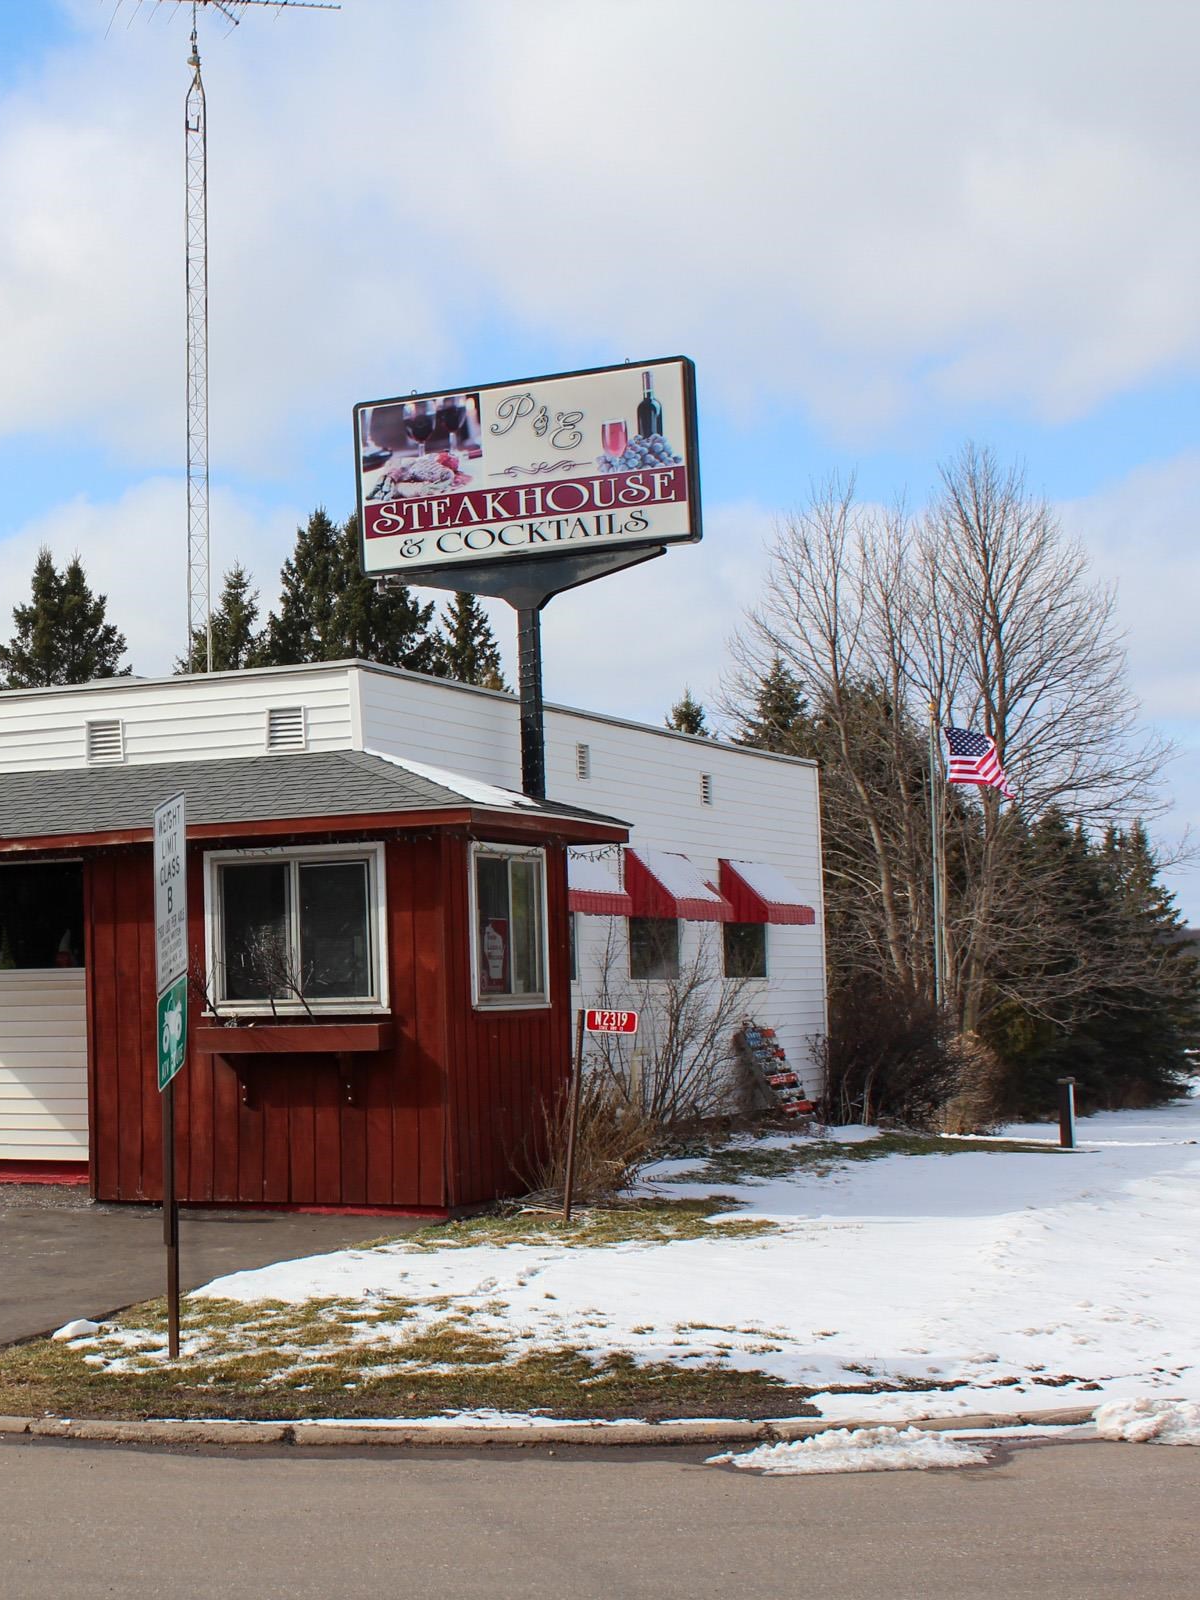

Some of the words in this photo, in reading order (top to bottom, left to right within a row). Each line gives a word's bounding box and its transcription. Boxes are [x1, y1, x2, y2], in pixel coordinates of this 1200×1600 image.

[371, 470, 677, 535] STEAKHOUSE
[399, 537, 424, 559] &
[435, 509, 649, 554] COCKTAILS
[159, 804, 180, 836] WEIGHT
[161, 831, 177, 860] LIMIT
[160, 855, 180, 886] CLASS
[167, 886, 173, 914] B
[595, 1011, 628, 1026] N2319
